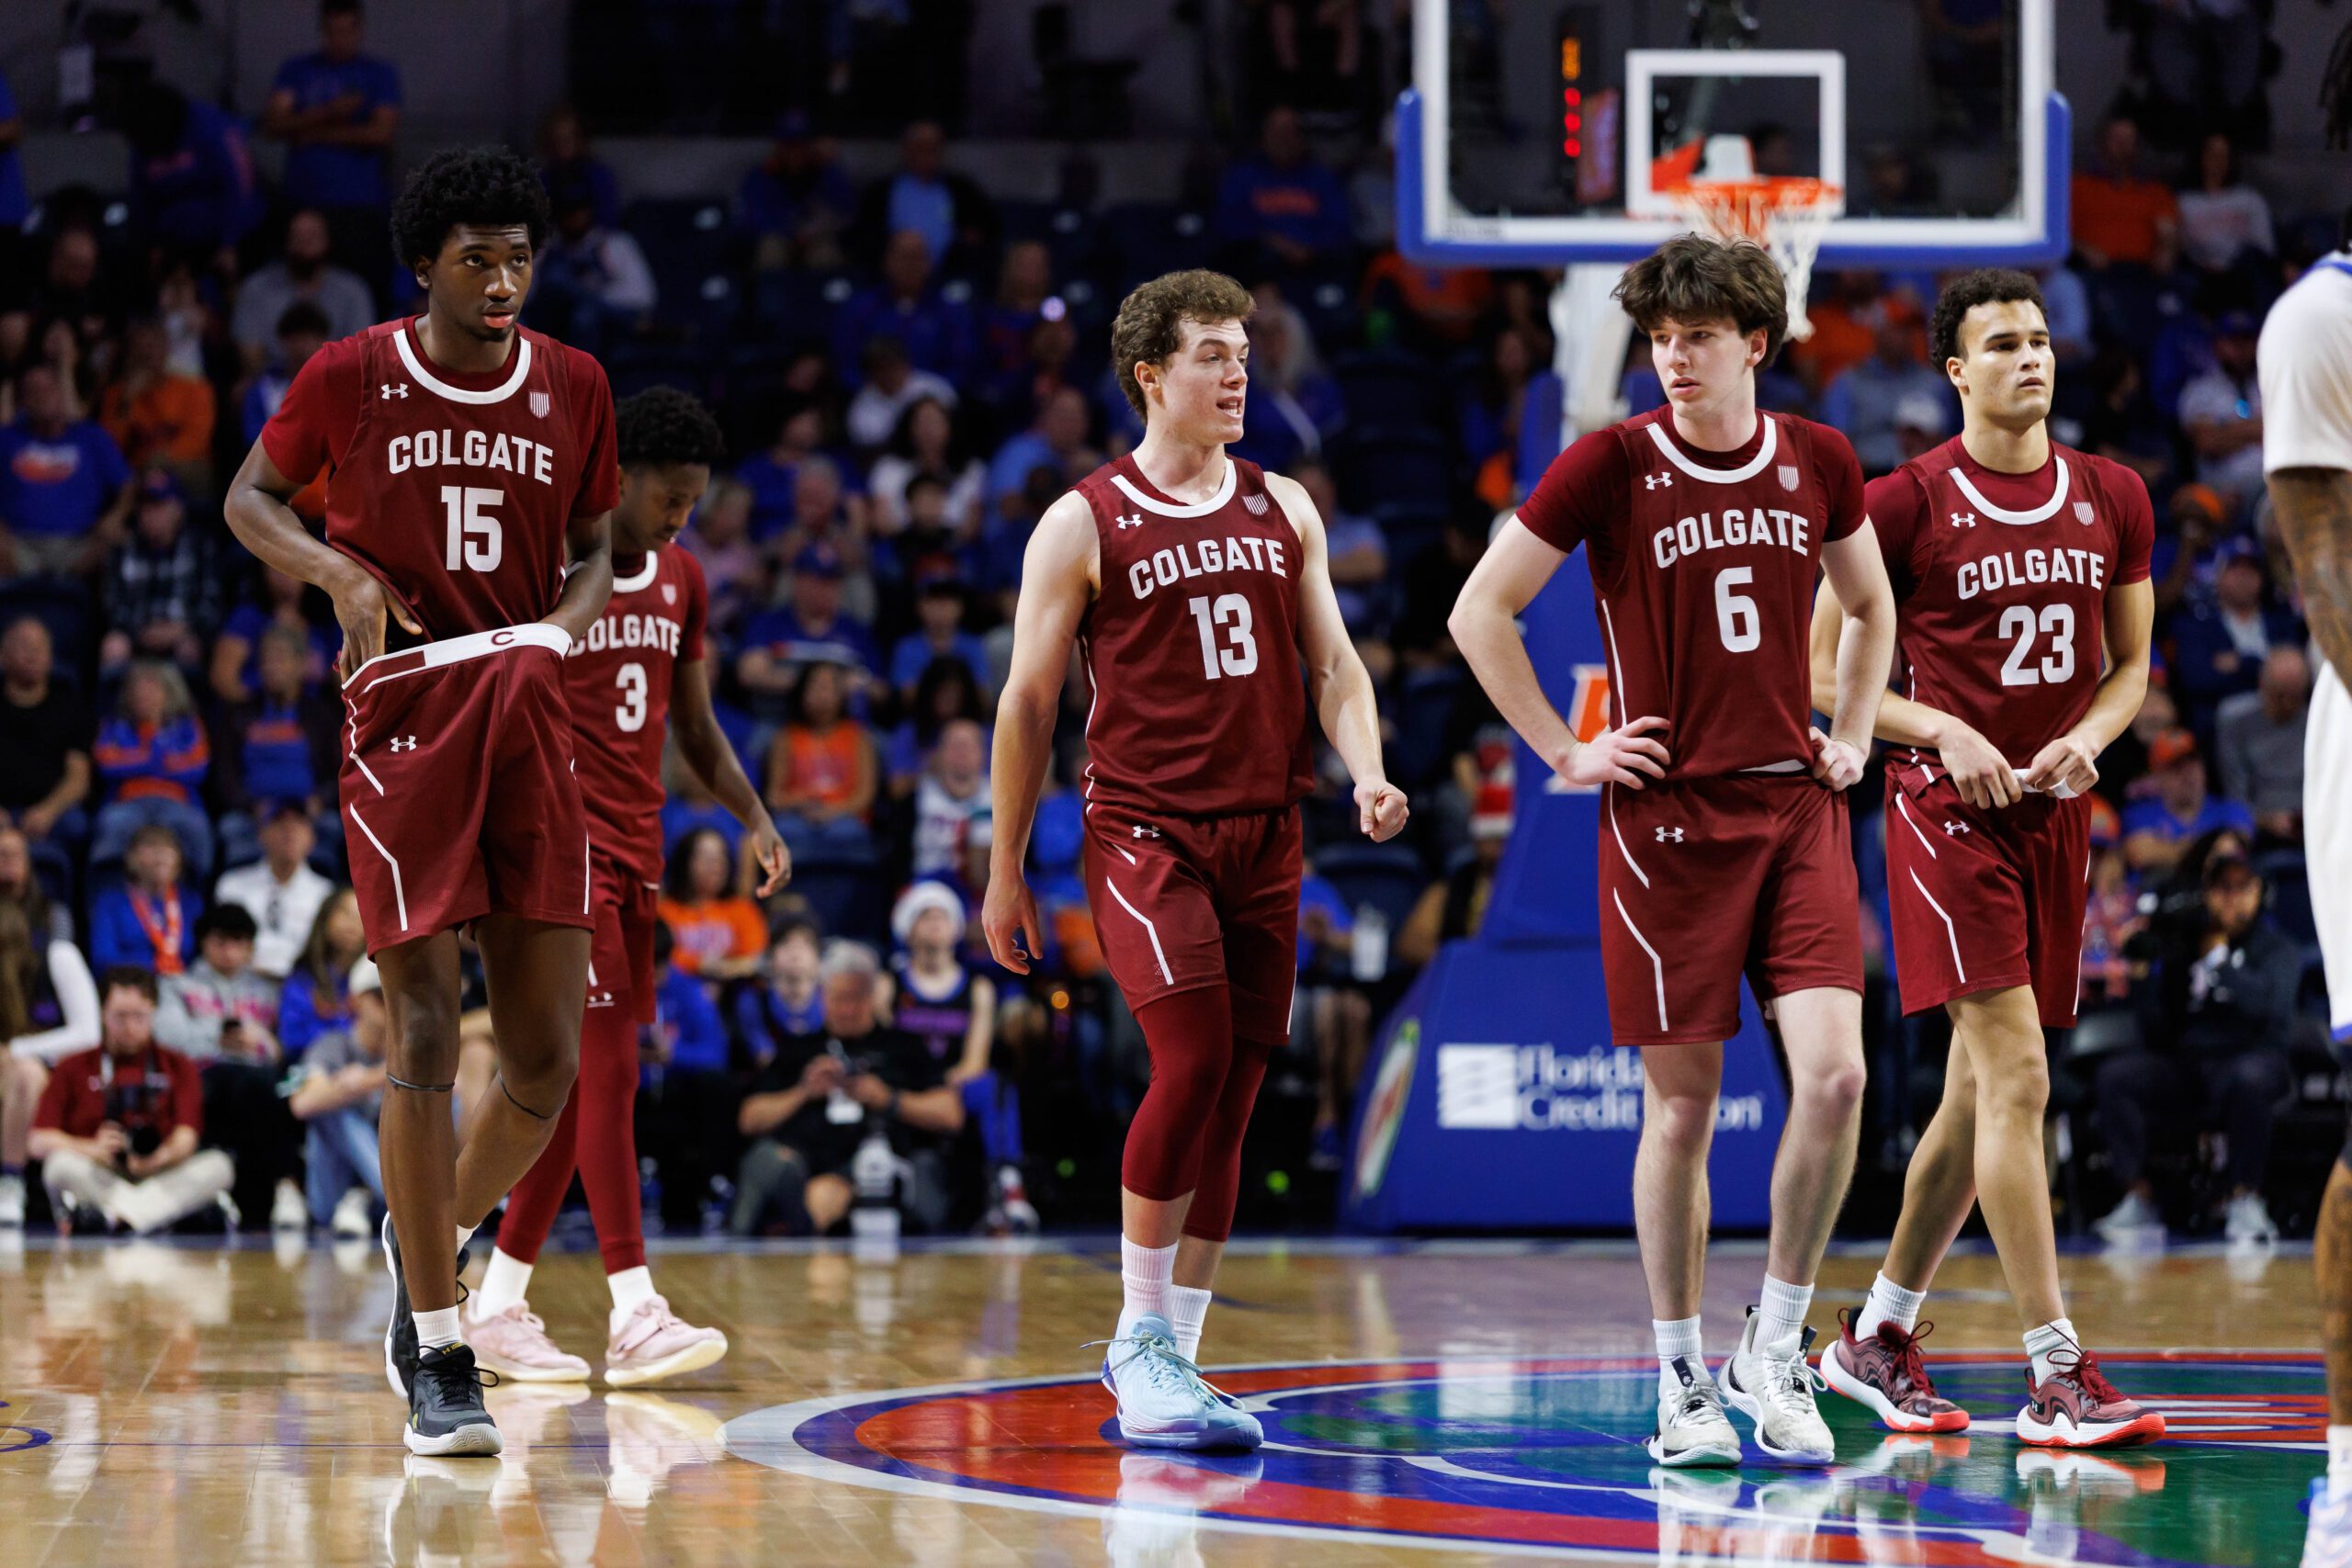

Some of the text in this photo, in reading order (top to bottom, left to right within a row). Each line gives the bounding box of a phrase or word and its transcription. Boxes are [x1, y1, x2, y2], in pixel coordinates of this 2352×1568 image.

[388, 428, 554, 486] COLGATE
[440, 485, 504, 573] 15
[1653, 507, 1809, 569] COLGATE
[1128, 536, 1288, 600] COLGATE
[1957, 547, 2105, 601] COLGATE
[491, 631, 515, 646] C
[1188, 592, 1259, 681] 13
[1714, 566, 1761, 653] 6
[1998, 603, 2075, 687] 23
[615, 662, 648, 732] 3
[1521, 1087, 1638, 1130] Credit
